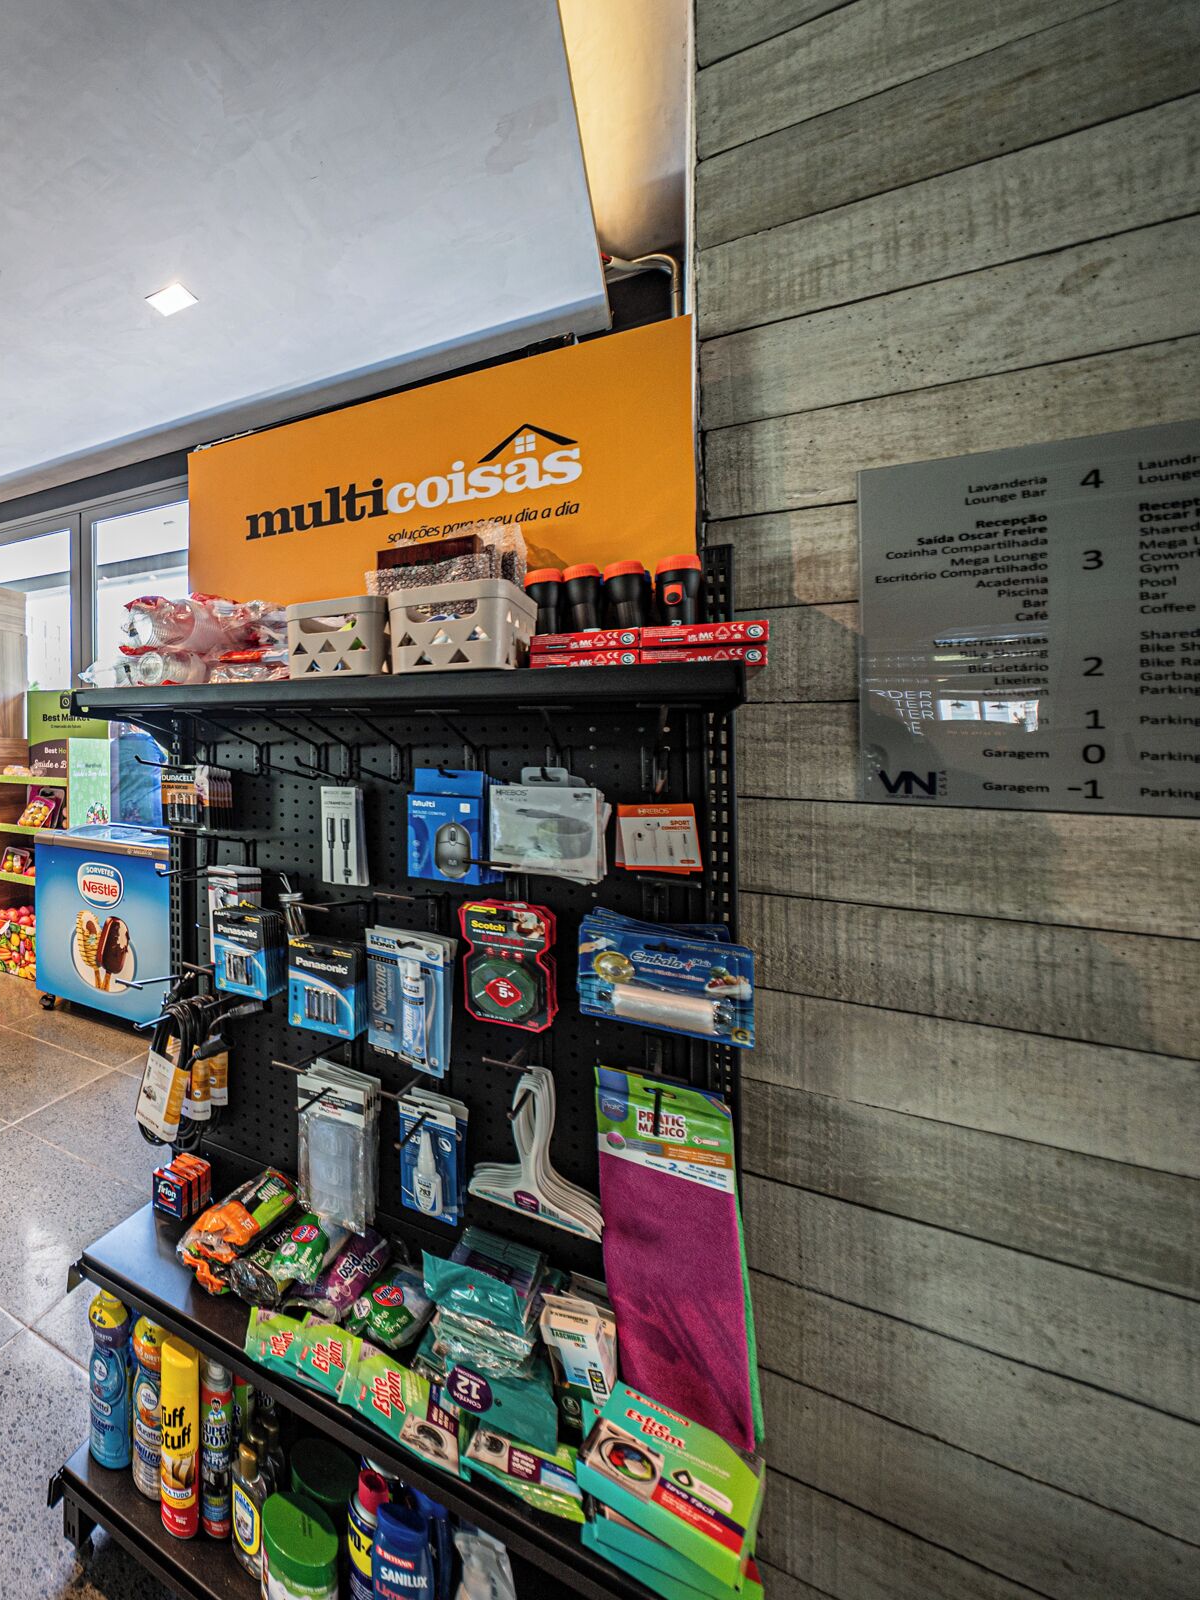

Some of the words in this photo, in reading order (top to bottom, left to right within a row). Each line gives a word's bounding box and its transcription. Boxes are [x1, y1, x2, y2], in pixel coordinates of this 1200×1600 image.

[968, 475, 1048, 494] Lavanderia
[1080, 468, 1104, 489] 4
[246, 447, 582, 541] multicoisas
[964, 492, 1017, 506] Lounge
[1021, 488, 1047, 499] Bar
[387, 525, 440, 544] soluções
[515, 507, 538, 523] dia
[541, 509, 552, 519] a
[555, 501, 580, 516] dia
[975, 513, 1048, 529] Recepção
[1139, 511, 1191, 523] Oscar
[917, 533, 954, 546] Saída
[958, 530, 999, 542] Oscar
[1003, 525, 1048, 537] Freire
[885, 546, 938, 560] Cozinha
[941, 537, 1048, 555] Compartilhada
[1139, 539, 1188, 550] Mega
[951, 556, 990, 567] Mega
[994, 551, 1048, 563] Lounge
[1082, 550, 1104, 571] 3
[875, 572, 937, 584] Escritório
[940, 562, 1048, 578] Compartilhado
[1139, 563, 1180, 574] Gym
[975, 575, 1048, 588] Academia
[1140, 576, 1177, 588] Pool
[997, 587, 1048, 598] Piscina
[1140, 591, 1169, 601] Bar
[1022, 599, 1048, 608] Bar
[1140, 603, 1196, 614] Coffee
[1015, 610, 1048, 621] Café
[1140, 643, 1175, 653] Bike
[968, 662, 1049, 673] Bicicletário
[1082, 656, 1104, 677] 2
[1140, 658, 1175, 668] Bike
[994, 676, 1049, 685] Lixeiras
[42, 713, 60, 722] Best
[1085, 709, 1106, 730] 1
[982, 749, 1050, 760] Garagem
[1082, 744, 1106, 764] 0
[161, 774, 194, 782] DURACELL
[982, 782, 1050, 793] Garagem
[1067, 779, 1104, 800] -1
[412, 799, 436, 808] Multi
[86, 866, 115, 878] SORVETES
[217, 923, 258, 939] Panasonic
[470, 919, 506, 932] Scotch
[295, 956, 348, 975] Panasonic
[630, 950, 682, 969] Embala
[373, 963, 387, 1015] Silicone
[734, 1029, 748, 1042] G
[668, 1162, 678, 1172] 2
[419, 1187, 431, 1197] 793
[337, 1252, 360, 1280] PESO
[358, 1252, 380, 1278] PRA
[143, 1353, 161, 1361] DIRET
[455, 1374, 481, 1400] 12
[162, 1406, 185, 1428] Tuff
[173, 1489, 190, 1499] TUDO
[380, 1566, 428, 1589] SANILUX
